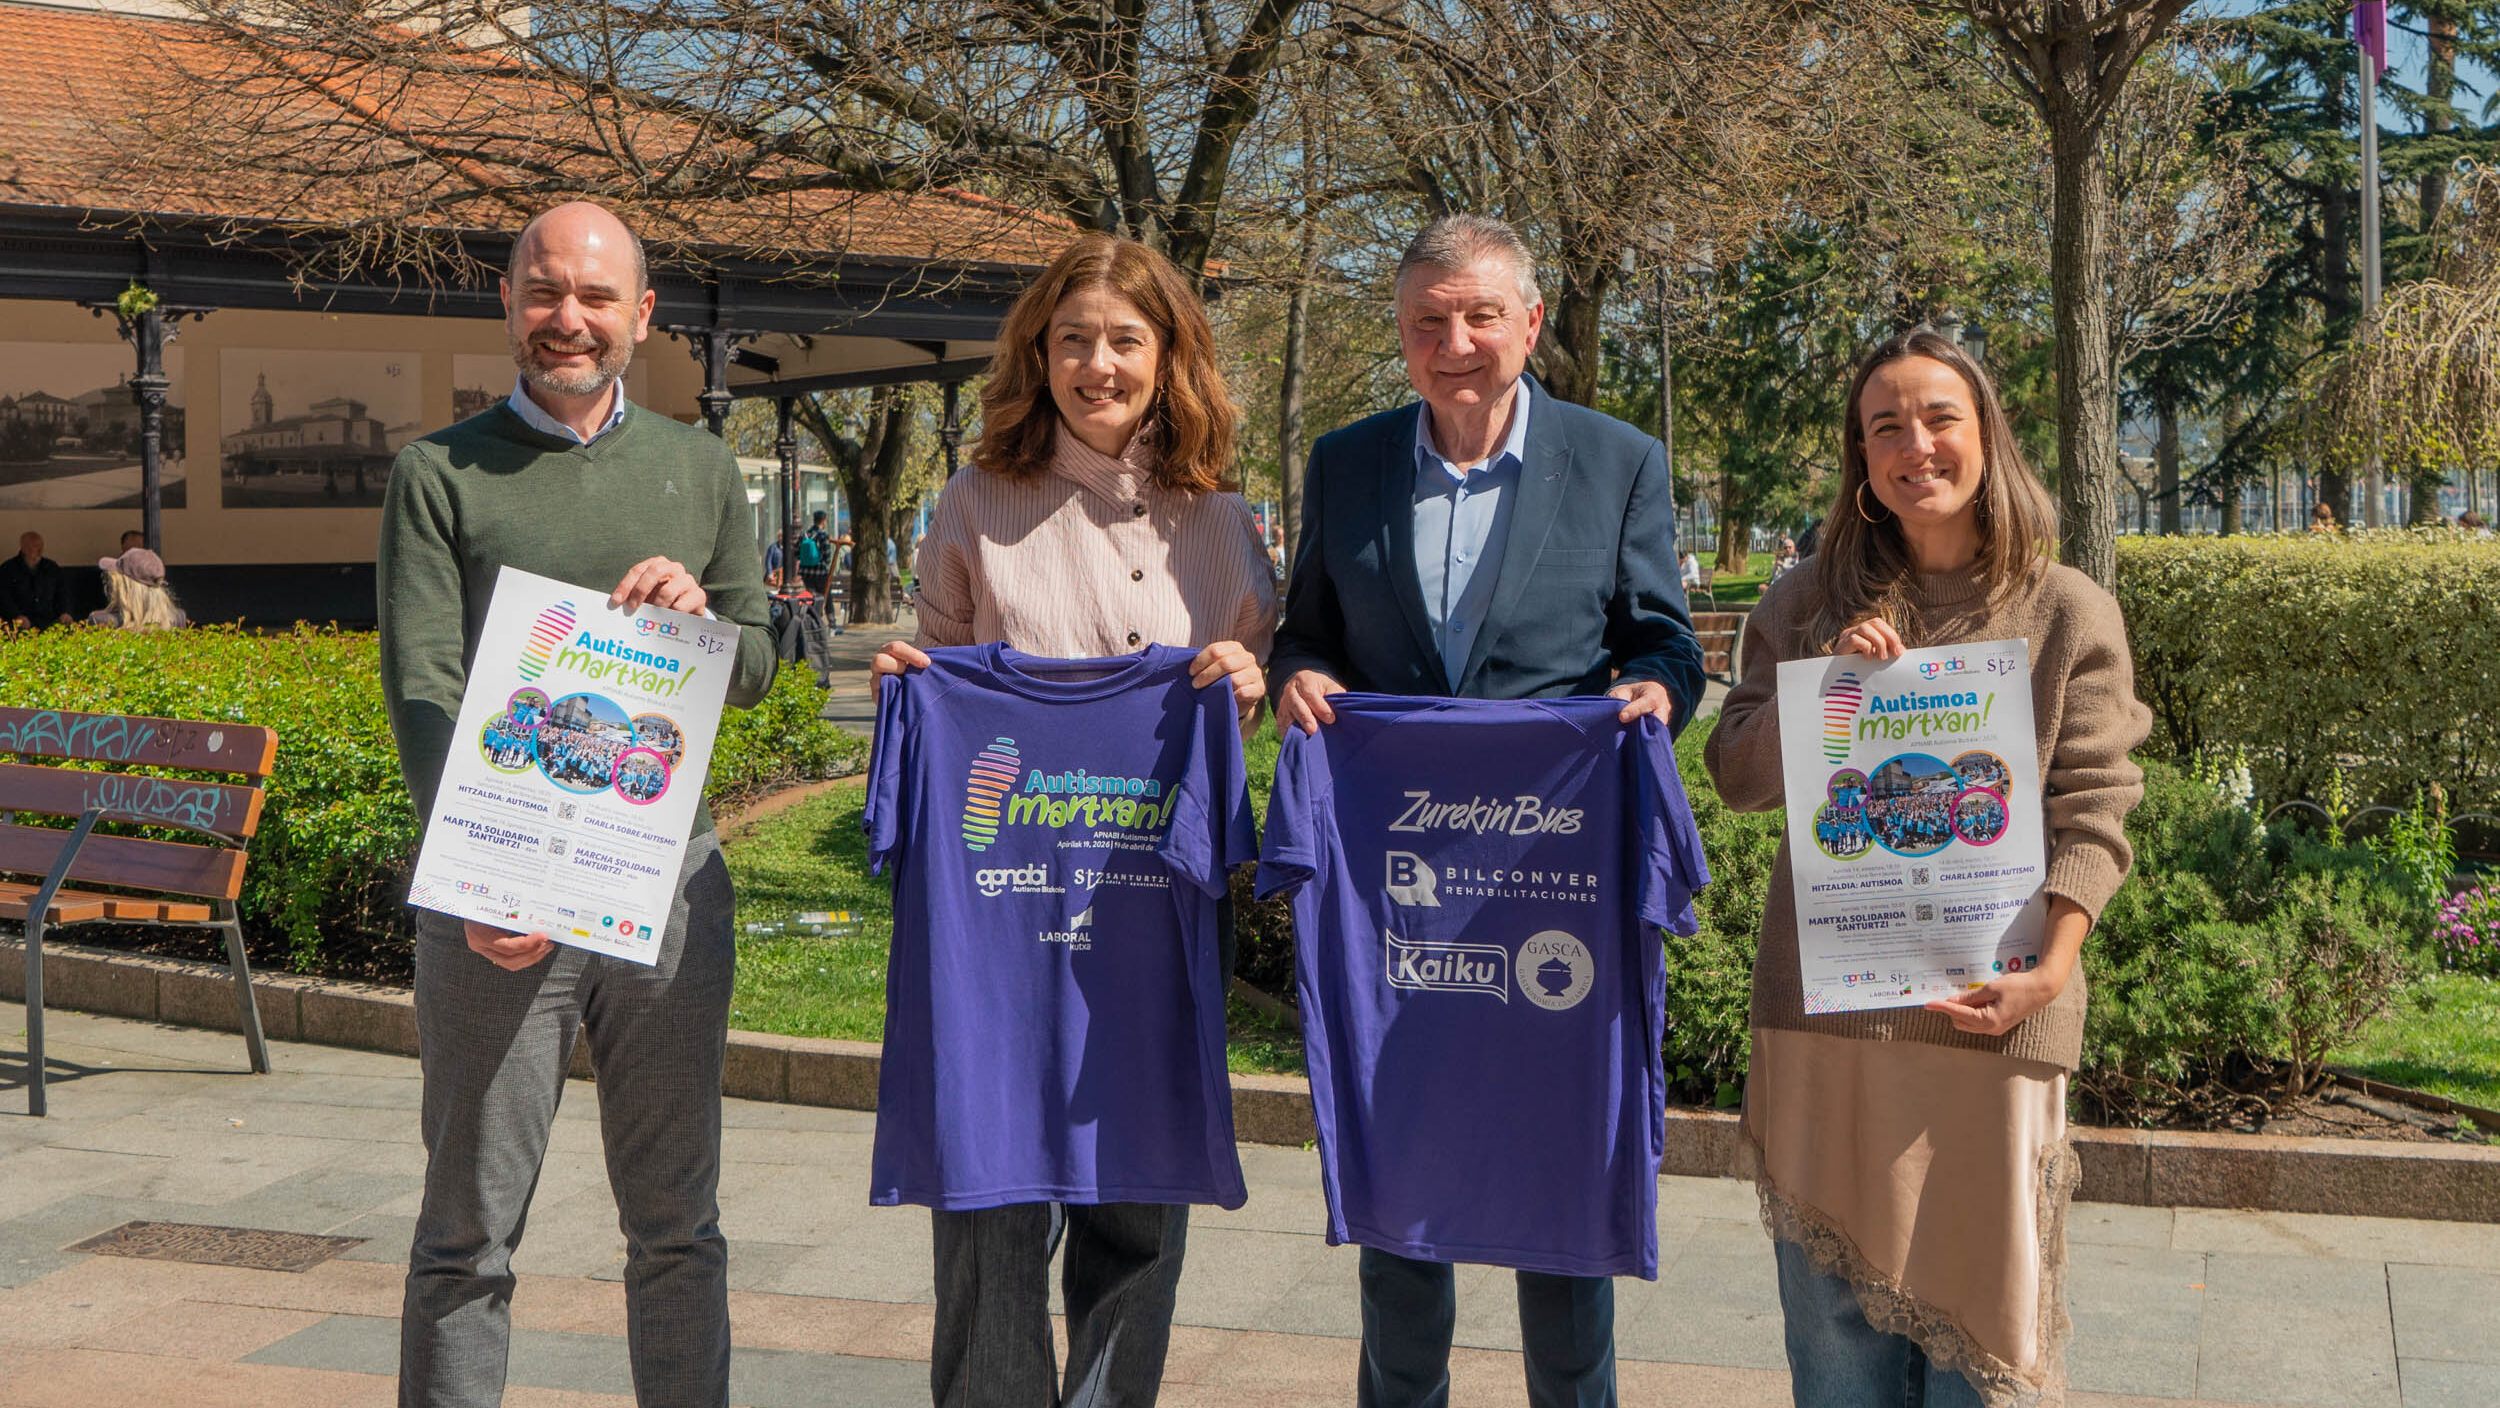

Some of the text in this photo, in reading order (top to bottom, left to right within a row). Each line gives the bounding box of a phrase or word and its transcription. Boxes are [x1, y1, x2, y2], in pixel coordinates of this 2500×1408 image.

[576, 631, 680, 673] Autismoa
[556, 646, 697, 697] martxan!
[1870, 691, 1978, 714] Autismoa
[1858, 692, 1995, 741] martxan!
[1024, 769, 1161, 798] Autismoa
[506, 796, 548, 812] AUTISMOA
[1007, 784, 1179, 829] martxan!
[443, 815, 482, 831] MARTXA
[483, 825, 540, 846] SOLIDARIOA
[584, 816, 615, 831] CHARLA
[615, 825, 640, 837] SOBRE
[641, 832, 677, 847] AUTISMO
[1094, 831, 1120, 839] APNABI
[1120, 832, 1148, 842] Autismo
[468, 830, 521, 850] SANTURTZI
[1093, 840, 1110, 849] 2026
[573, 856, 622, 876] SANTURTZI
[576, 847, 613, 864] MARCHA
[614, 858, 661, 877] SOLIDARIA
[1105, 872, 1169, 883] SANTURTZI
[1446, 867, 1598, 888] BILCONVER
[1940, 872, 1973, 882] CHARLA
[1974, 869, 2000, 879] SOBRE
[2001, 866, 2036, 876] AUTISMO
[1860, 878, 1904, 889] AUTISMOA
[1446, 886, 1597, 903] REHABILITACIONES
[1943, 904, 1983, 915] MARCHA
[1984, 898, 2030, 912] SOLIDARIA
[1808, 911, 1907, 926] MARTXA SOLIDARIOA
[1836, 920, 1889, 932] SANTURTZI
[1943, 912, 1994, 924] SANTURTZI
[1039, 931, 1092, 943] LABORAL
[1070, 942, 1092, 951] kutxa
[1527, 941, 1582, 958] GASCA
[1397, 948, 1496, 987] Kaiku
